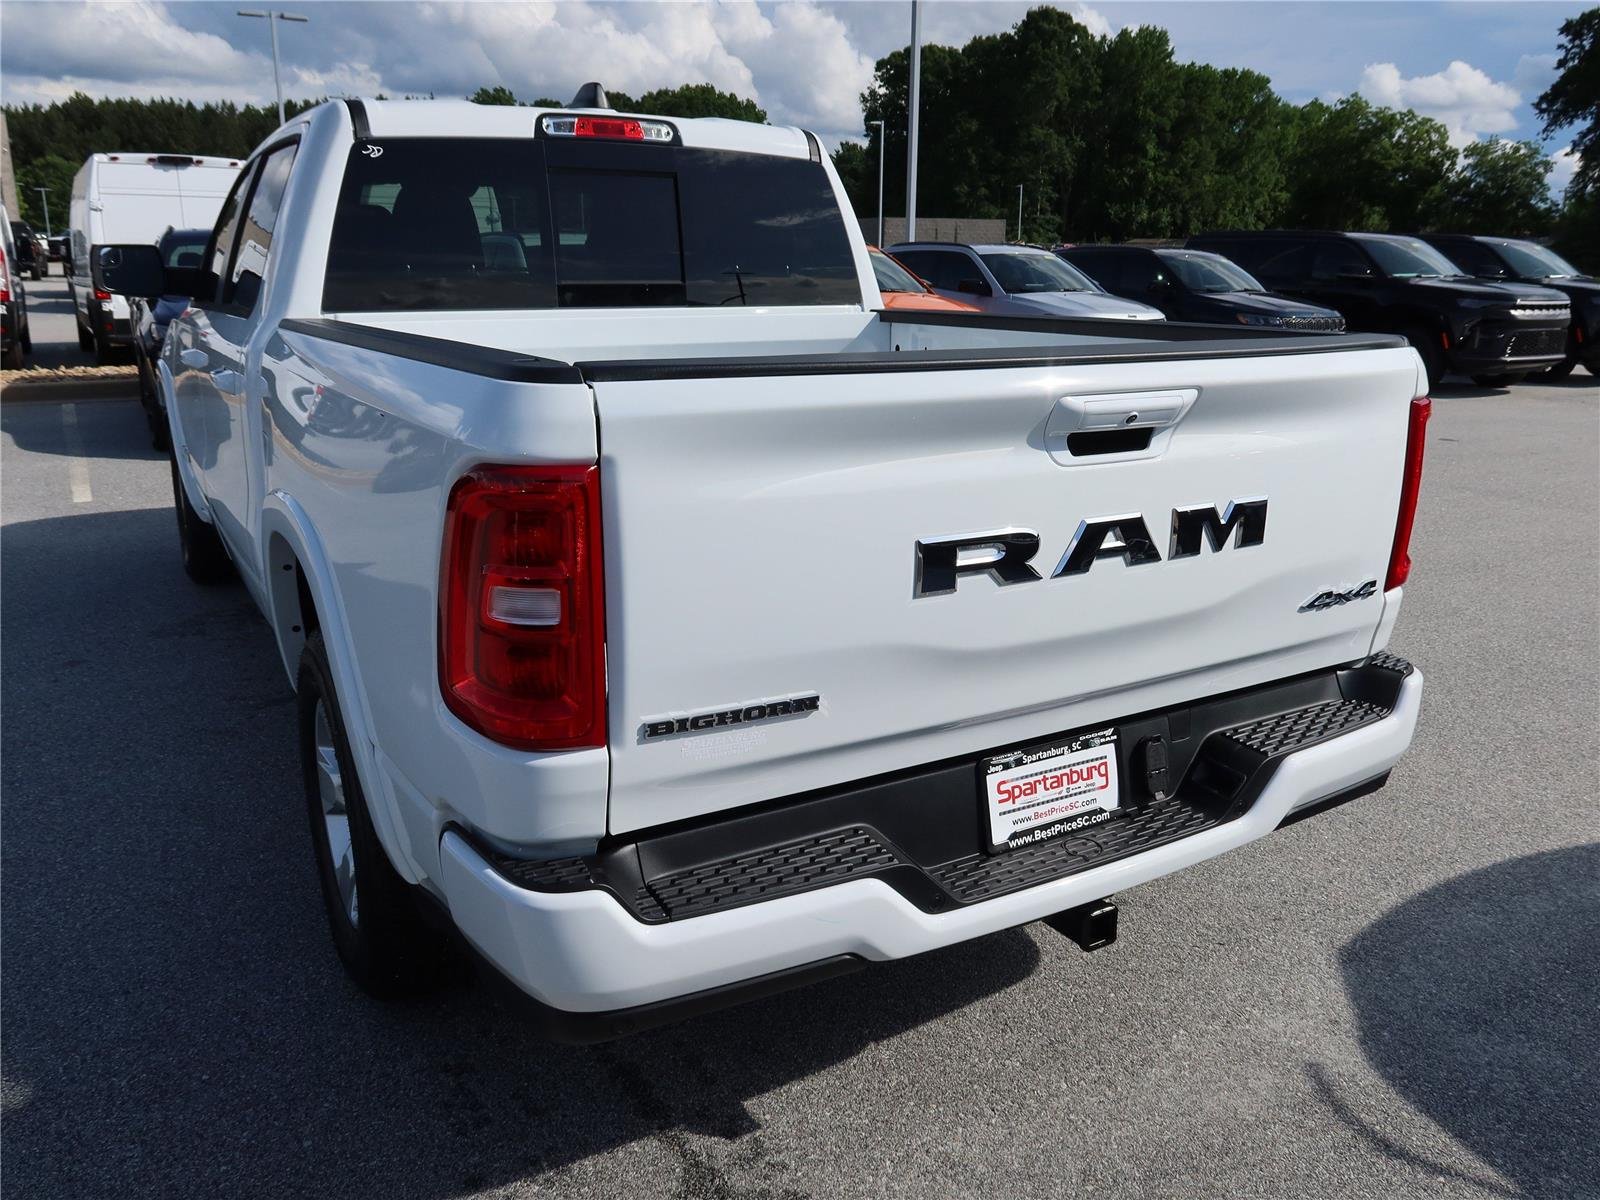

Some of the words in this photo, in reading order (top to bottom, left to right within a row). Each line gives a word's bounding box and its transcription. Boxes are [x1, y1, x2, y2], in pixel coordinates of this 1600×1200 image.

[912, 495, 1269, 600] RAM
[638, 691, 820, 743] BIGHORN
[1022, 745, 1071, 765] Spartanburg,
[1071, 741, 1082, 751] SC
[1100, 735, 1117, 743] RAM
[987, 764, 1003, 774] Jeep
[997, 761, 1109, 804] Spartanburg
[1011, 797, 1097, 826] www.BestPriceSC.com
[1008, 811, 1110, 849] www.BestPriceSC.com
